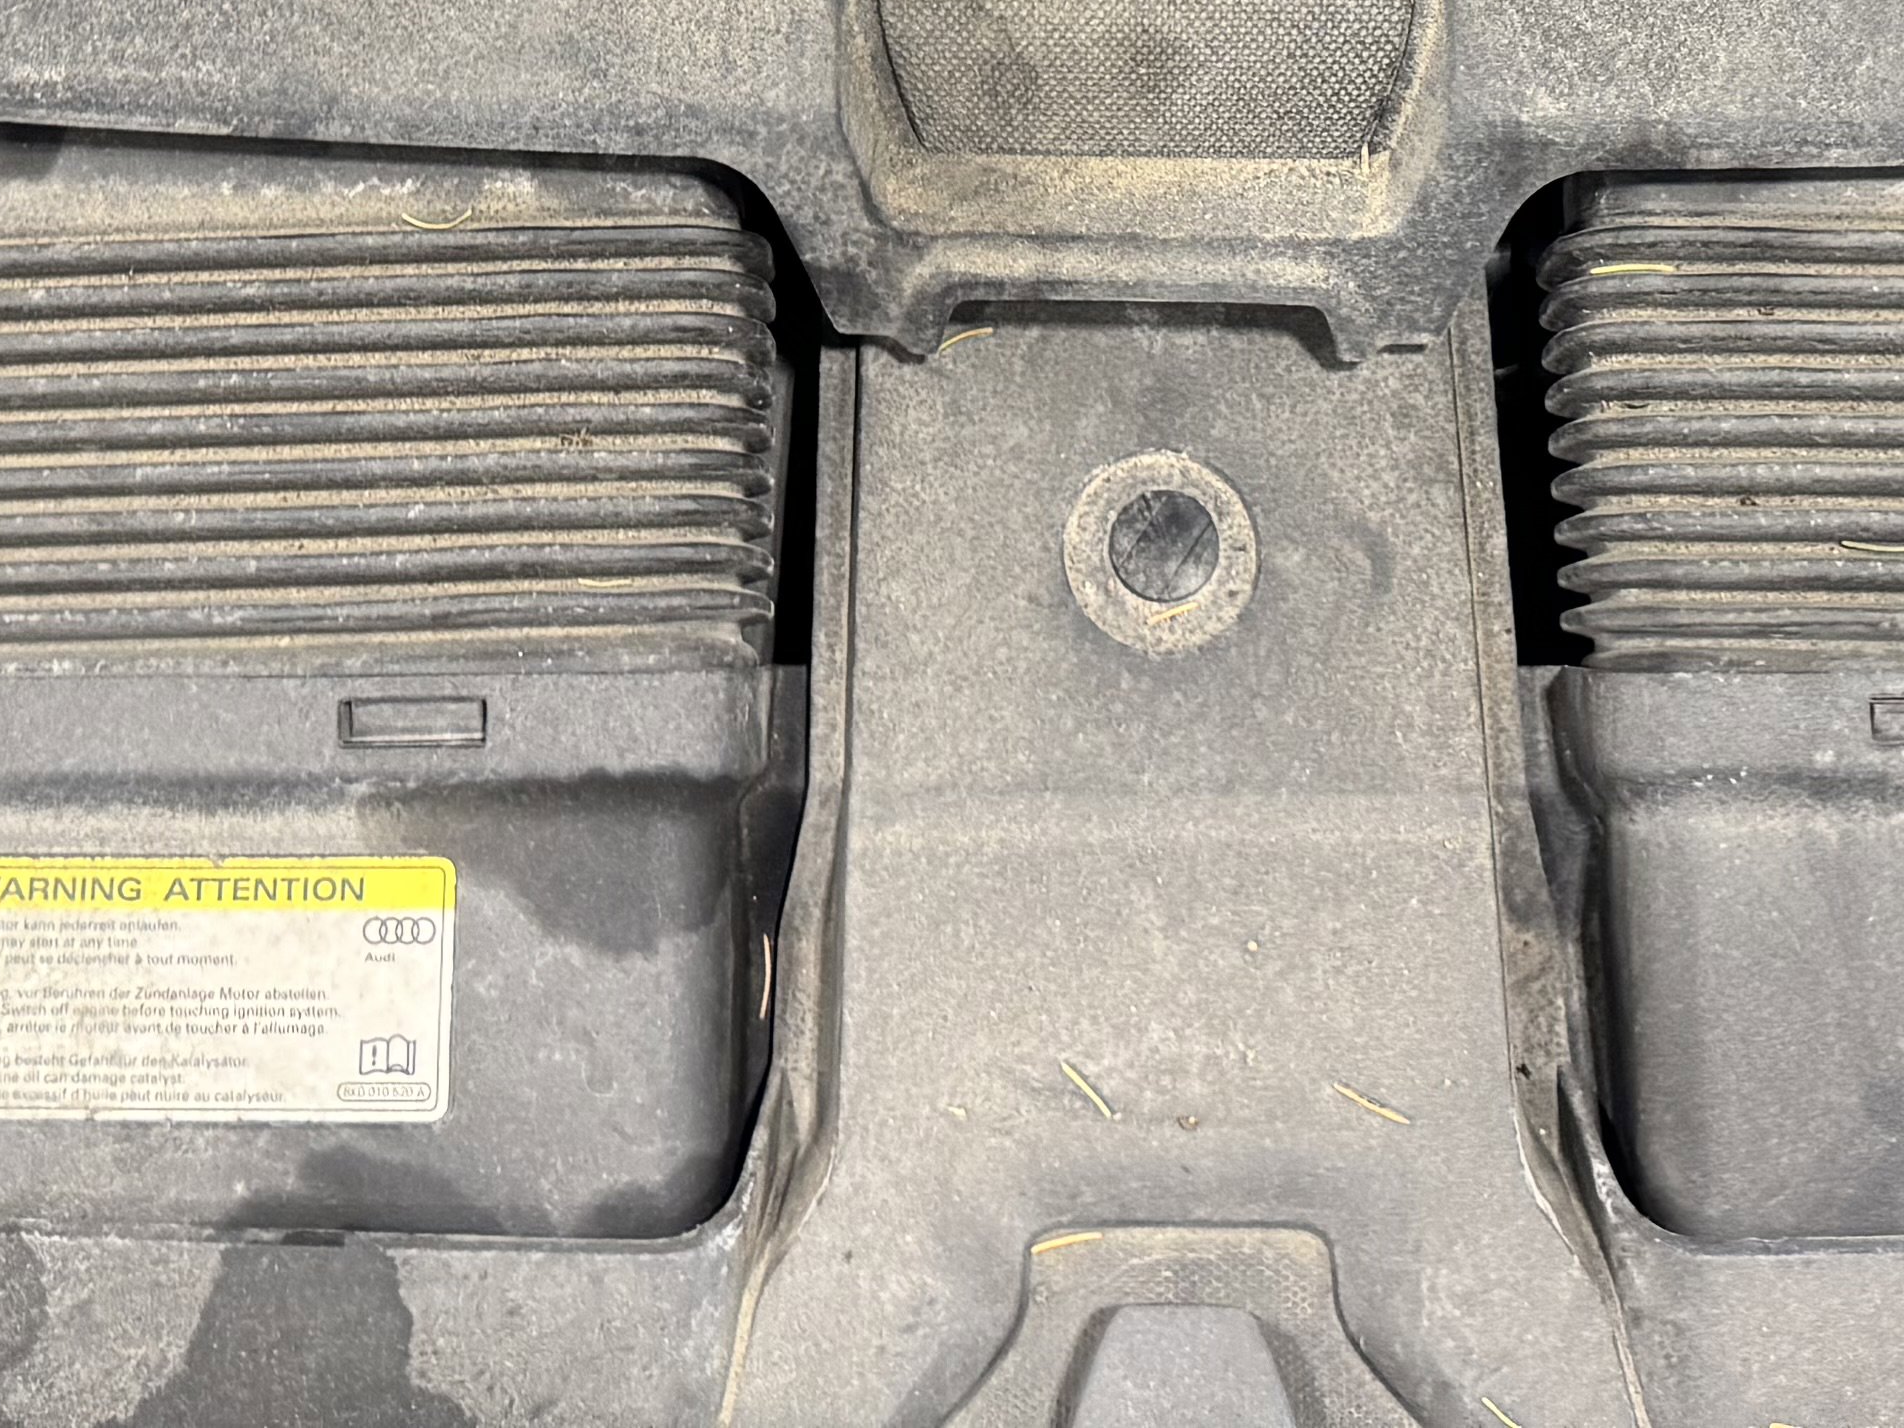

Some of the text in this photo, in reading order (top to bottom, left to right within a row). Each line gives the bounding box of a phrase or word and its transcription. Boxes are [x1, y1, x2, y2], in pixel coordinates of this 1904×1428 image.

[164, 878, 365, 903] ATTENTION
[364, 951, 396, 963] Audi
[50, 1002, 69, 1016] off
